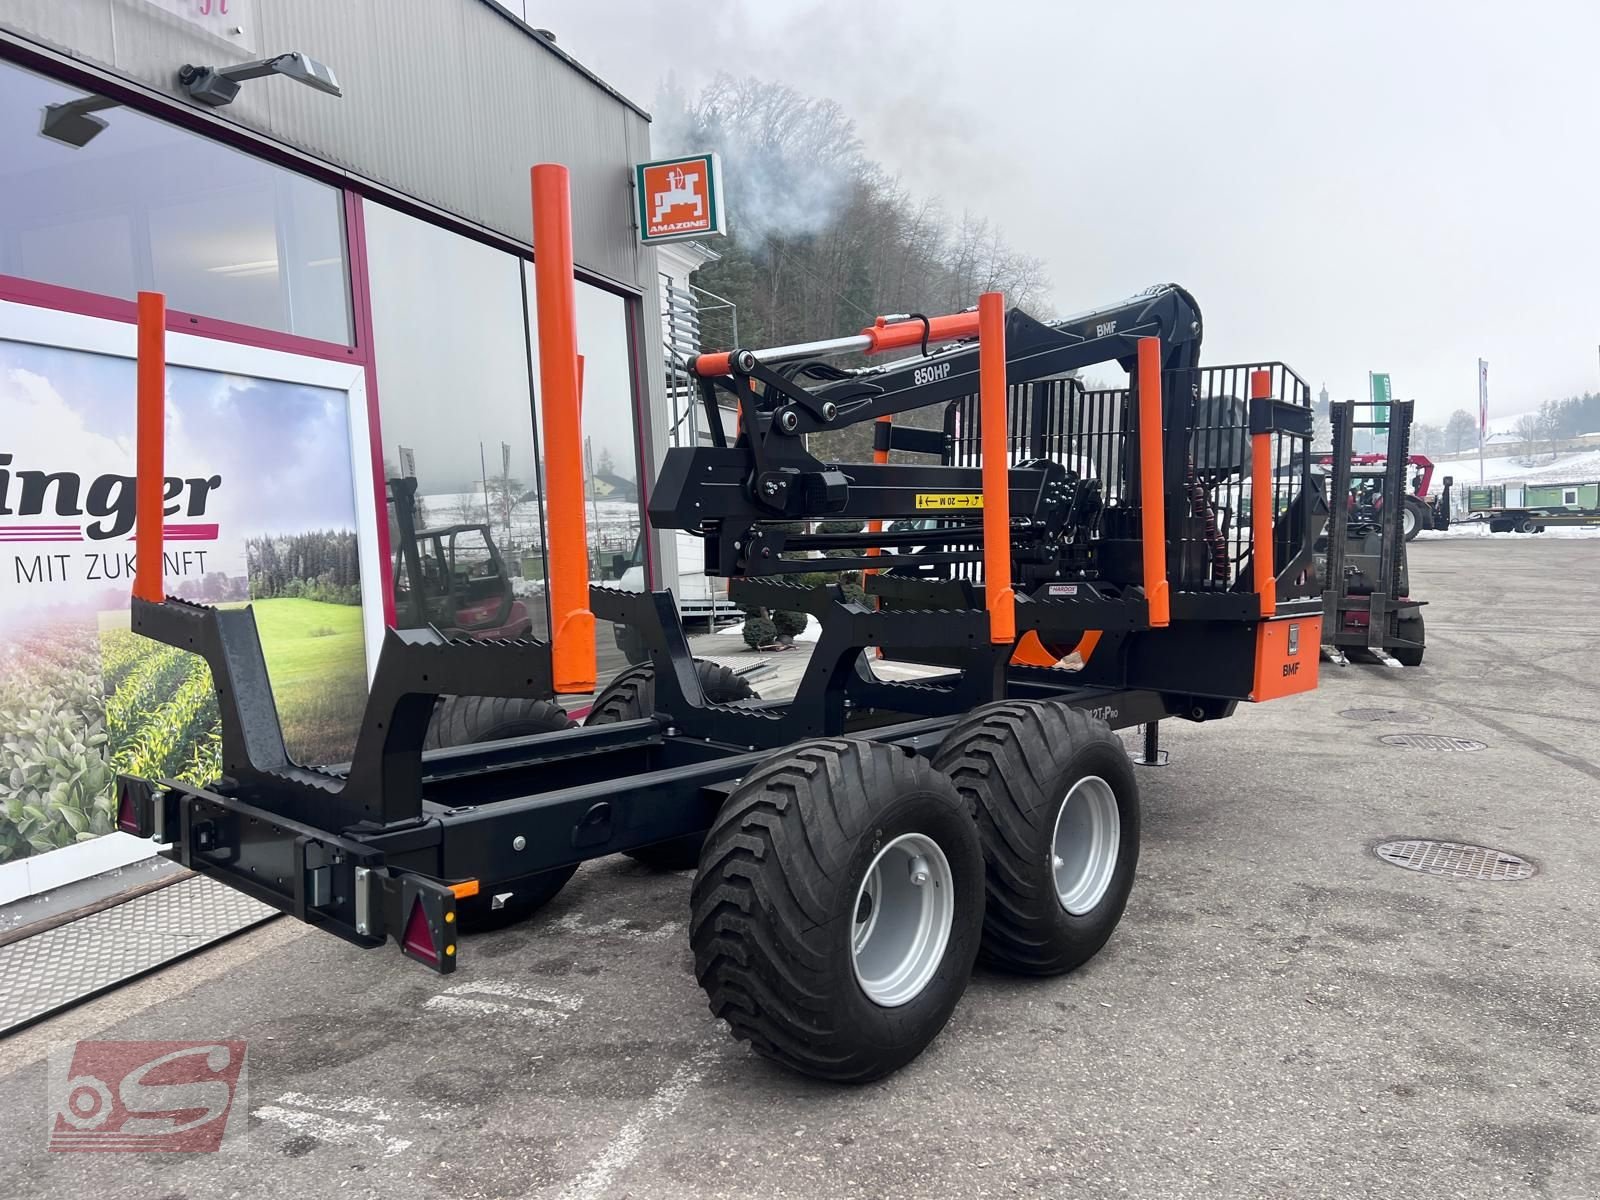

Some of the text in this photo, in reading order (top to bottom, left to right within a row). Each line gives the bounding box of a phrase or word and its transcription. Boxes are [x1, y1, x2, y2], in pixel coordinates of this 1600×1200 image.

[650, 219, 708, 233] AMAZONE
[1096, 320, 1118, 338] BMF
[913, 362, 951, 386] 850HP
[14, 550, 208, 583] MIT ZUKNFT
[1282, 662, 1300, 677] BMF
